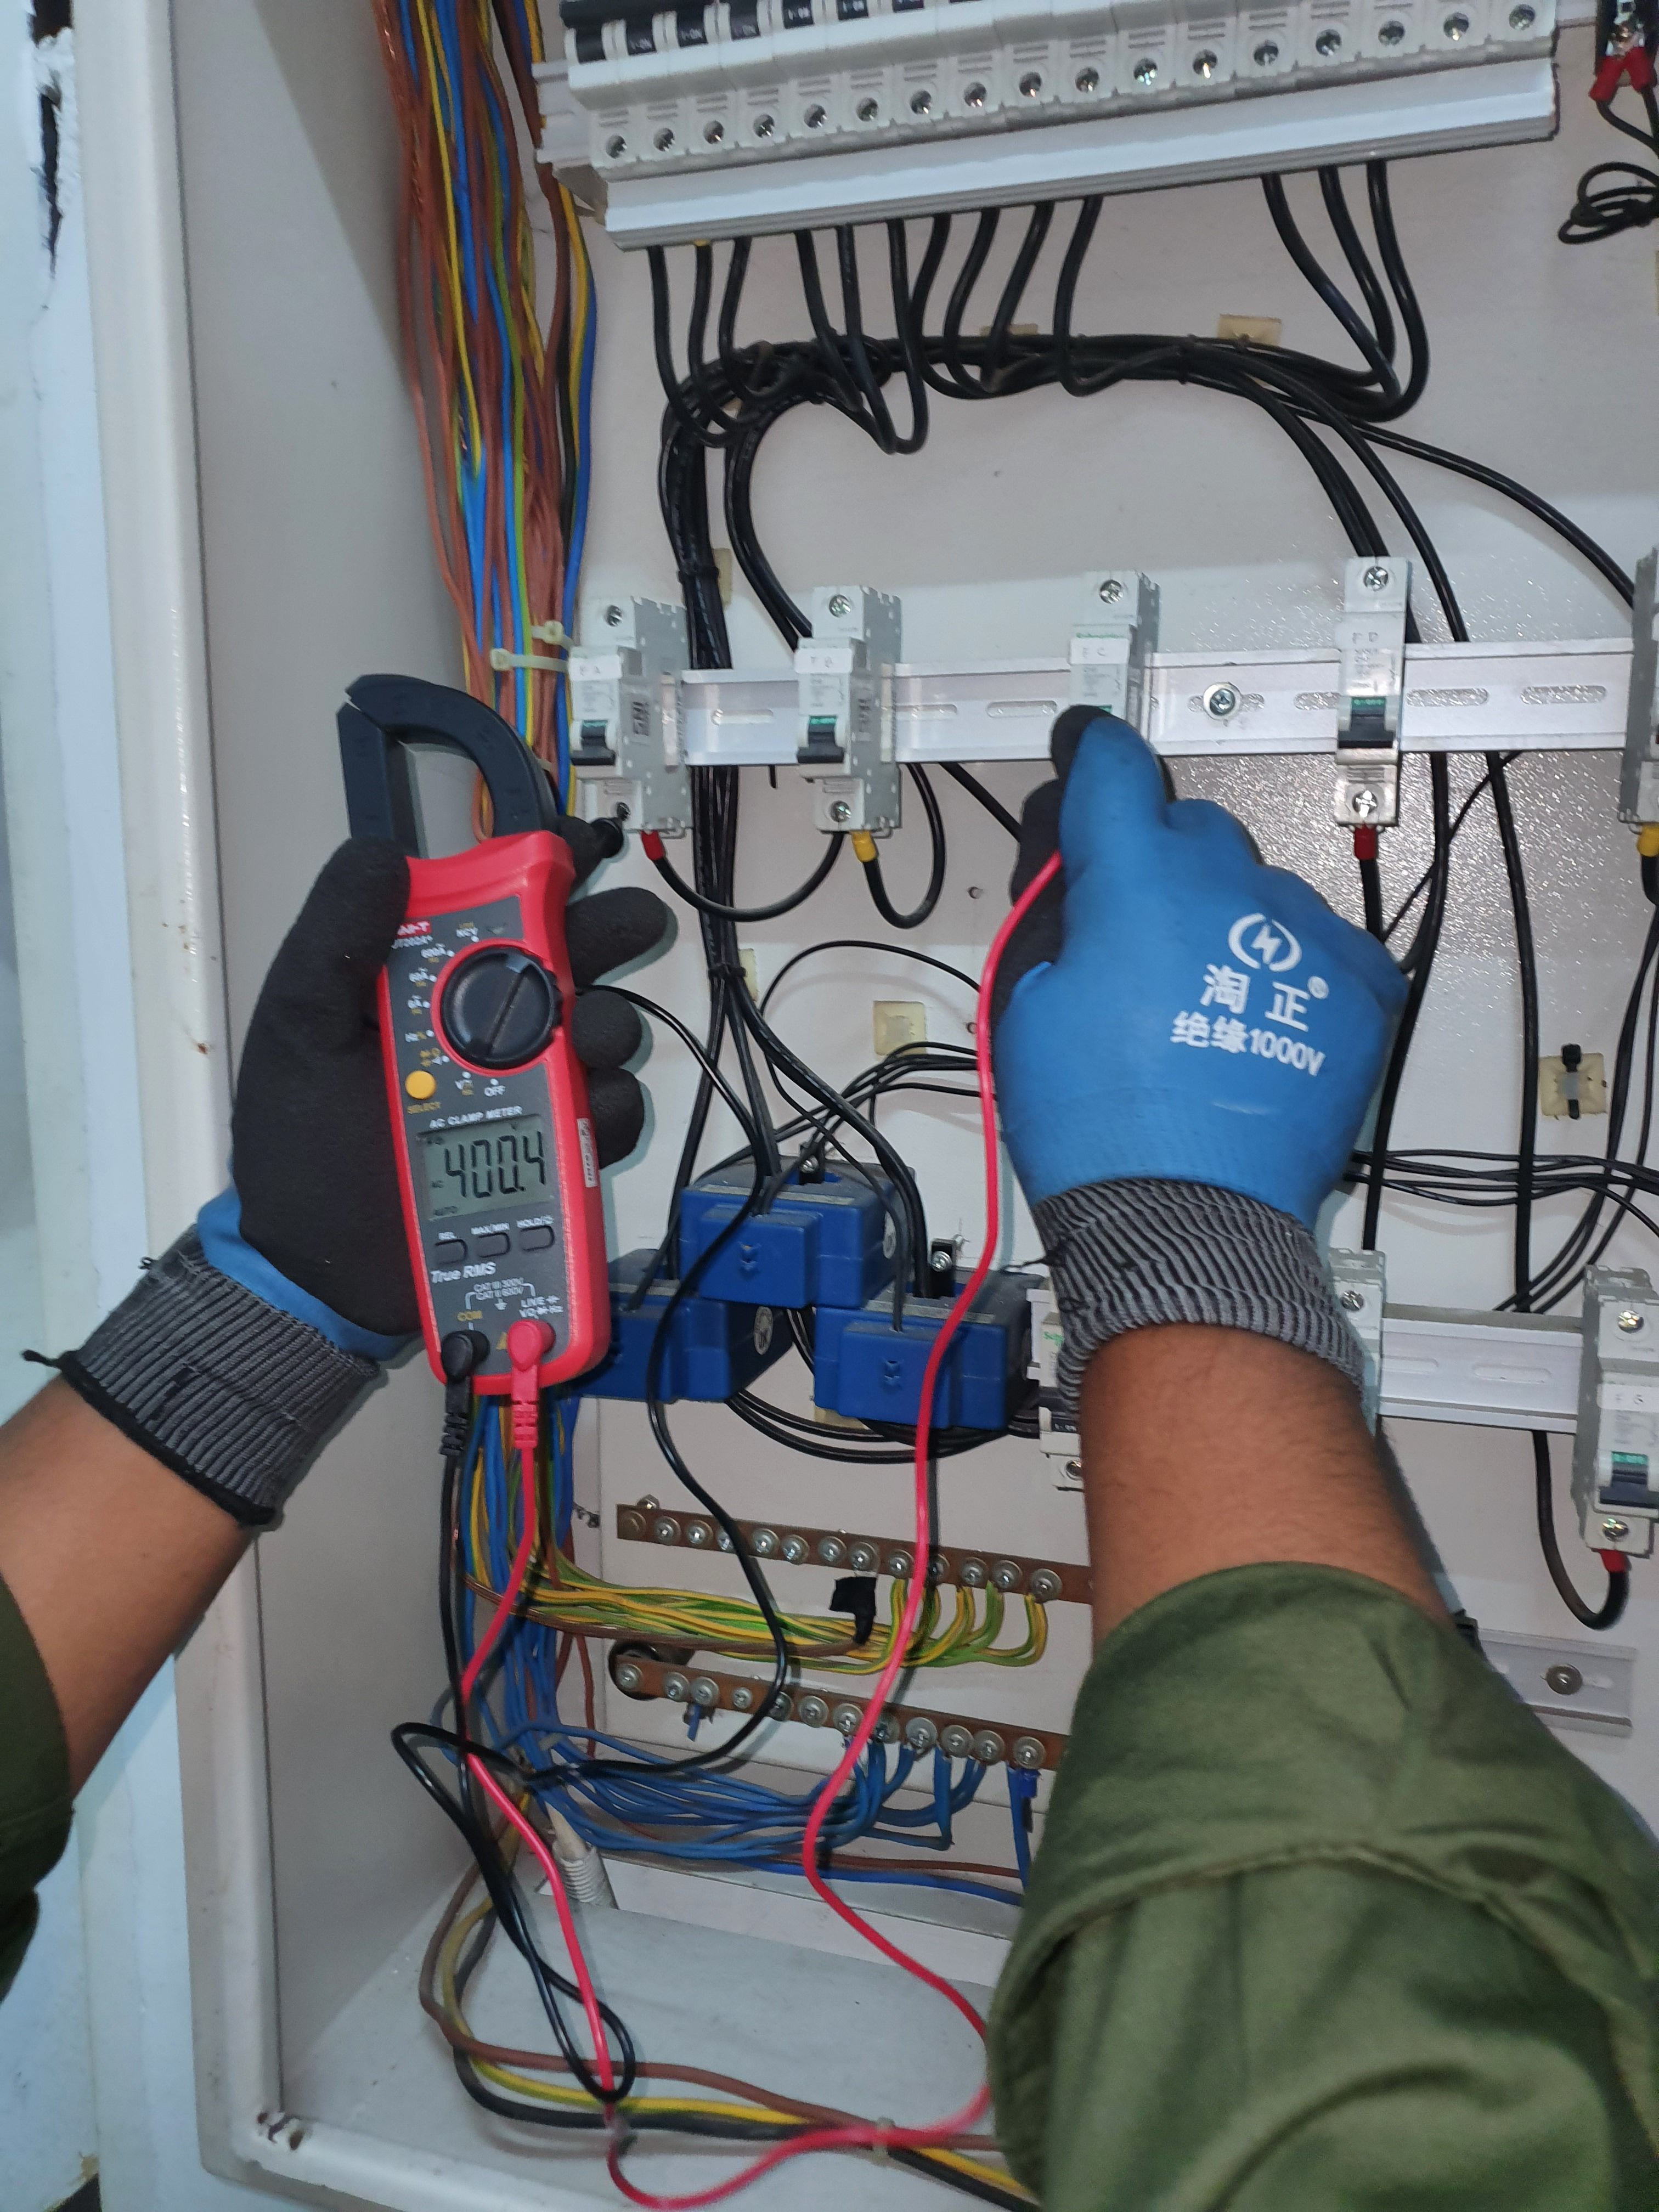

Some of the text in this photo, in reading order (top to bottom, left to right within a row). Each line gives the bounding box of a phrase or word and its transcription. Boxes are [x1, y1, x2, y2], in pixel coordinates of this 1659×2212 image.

[484, 1085, 506, 1097] OFF
[429, 1105, 523, 1129] AC CLAMP METER
[430, 1262, 496, 1283] True RMS
